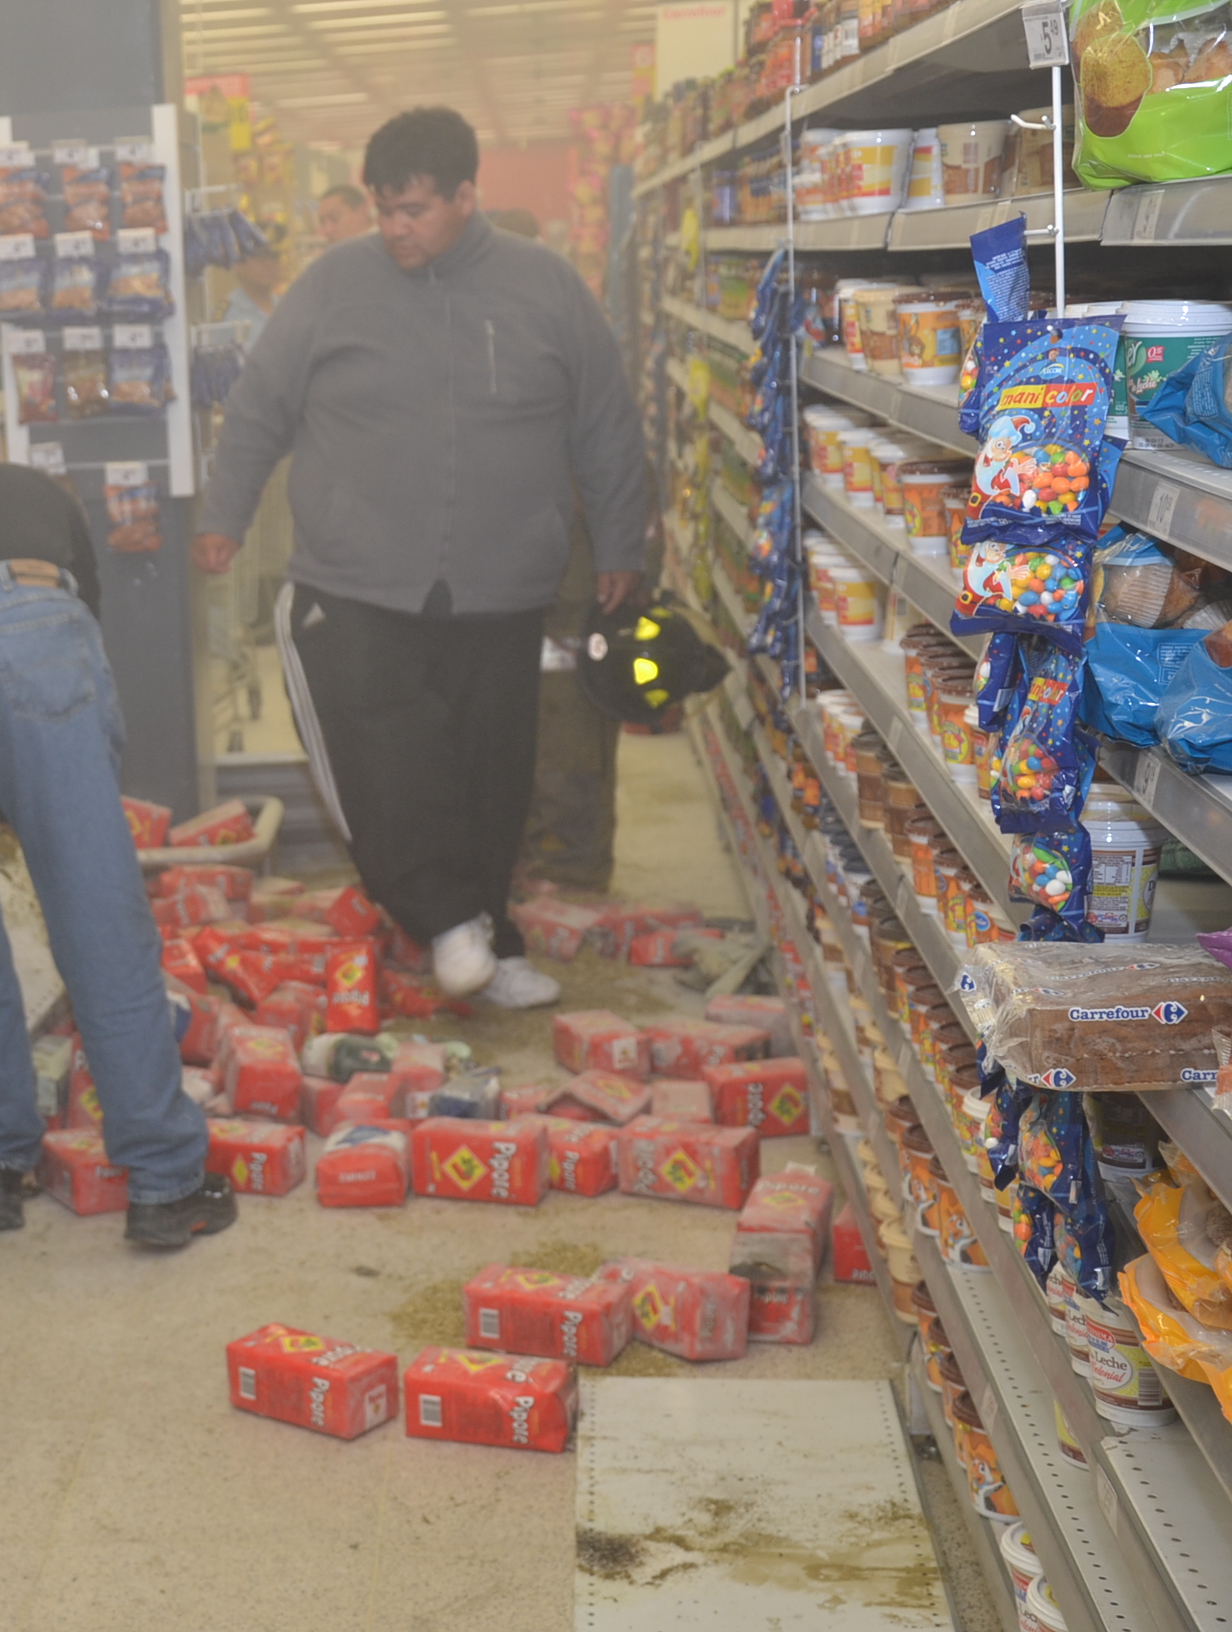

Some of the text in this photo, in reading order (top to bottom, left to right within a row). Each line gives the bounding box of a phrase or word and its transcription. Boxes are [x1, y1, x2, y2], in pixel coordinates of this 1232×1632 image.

[1000, 385, 1095, 407] mani color
[1069, 1006, 1149, 1021] Carrefour
[488, 1141, 518, 1200] Pipore
[1093, 1351, 1128, 1371] Leche
[509, 1395, 535, 1446] Pipore
